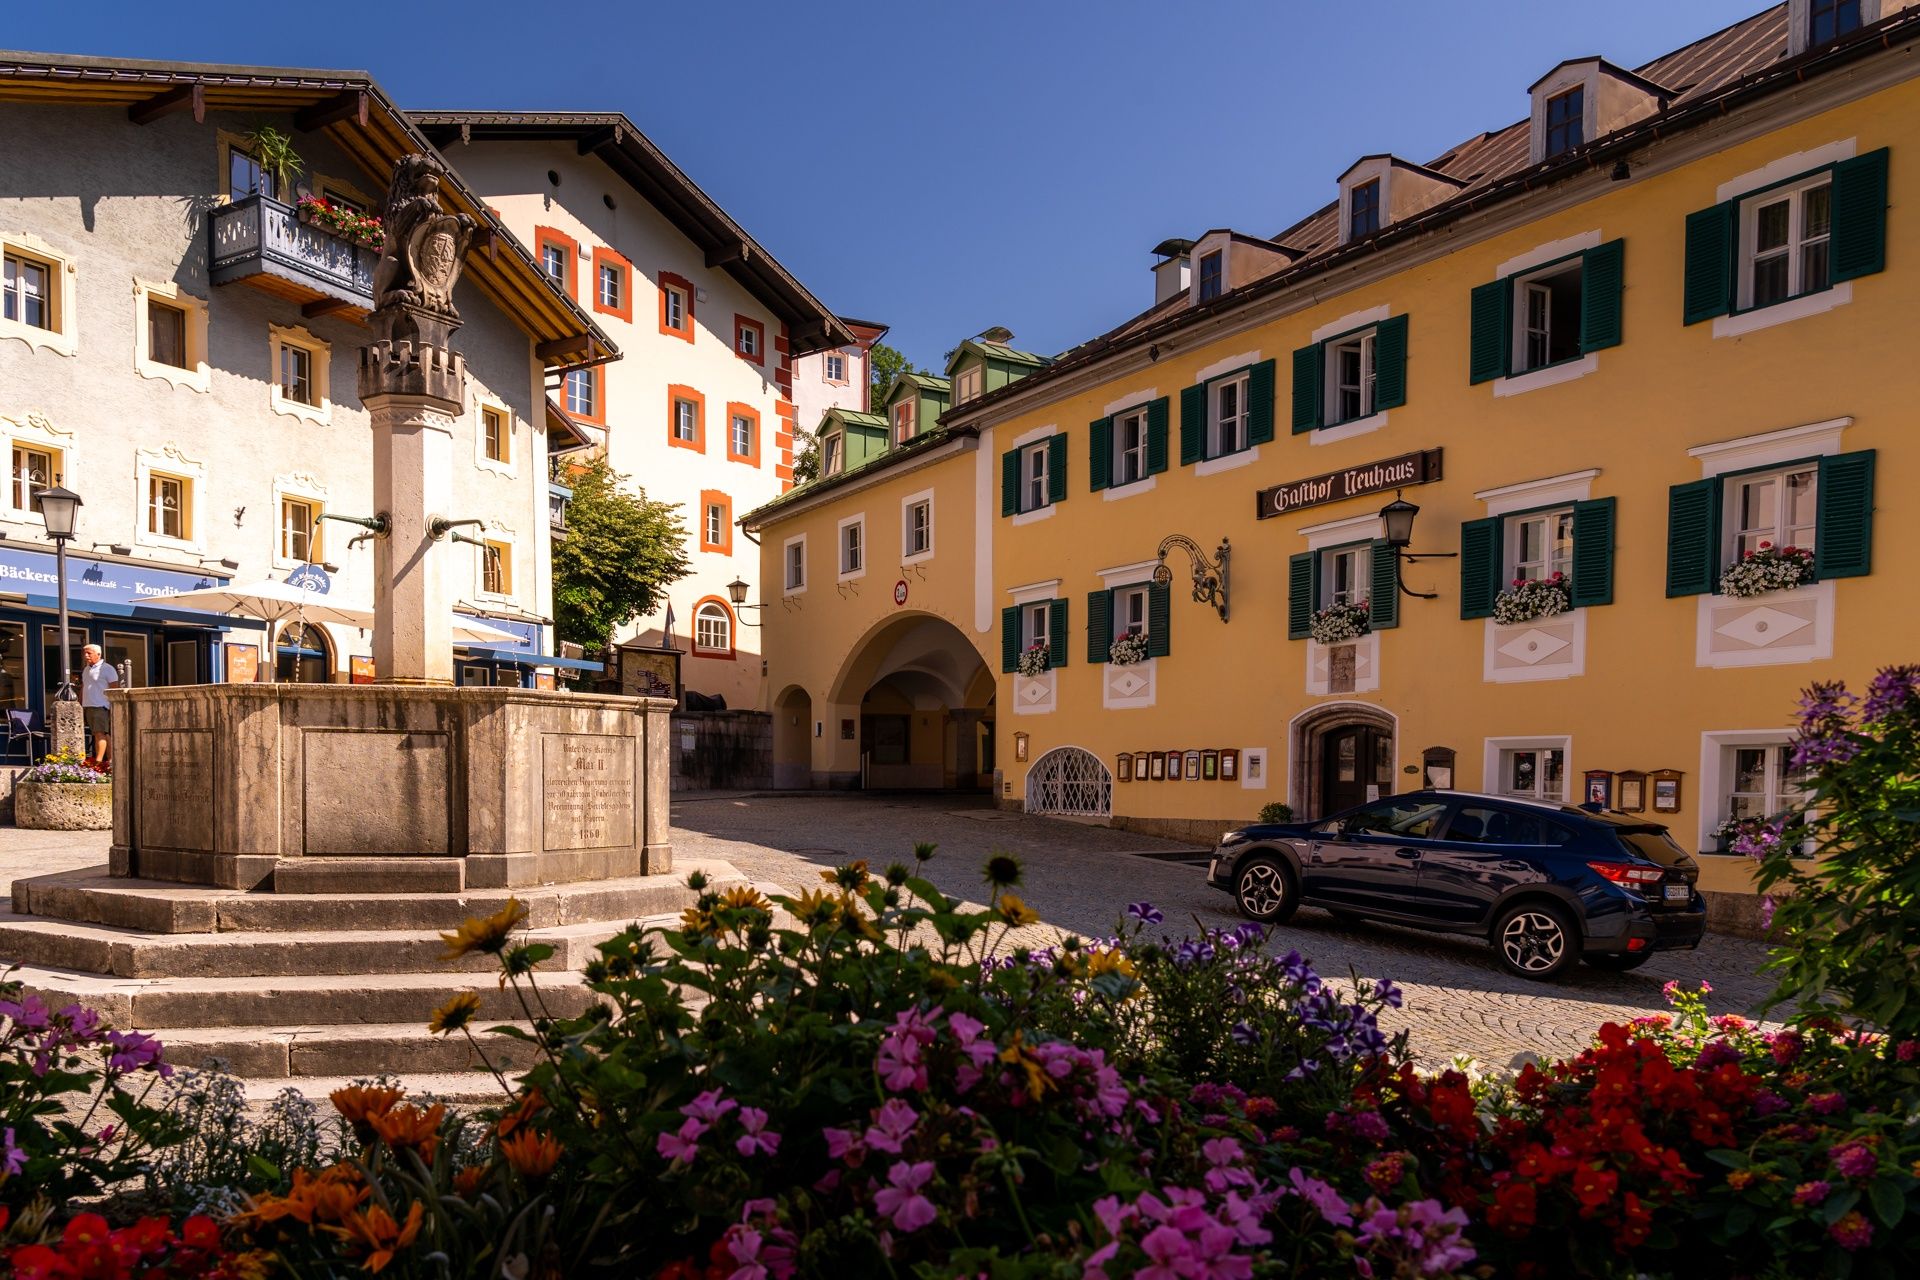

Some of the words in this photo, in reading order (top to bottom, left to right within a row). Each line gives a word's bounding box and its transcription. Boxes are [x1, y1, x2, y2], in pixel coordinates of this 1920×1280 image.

[1274, 475, 1335, 511] Gasthof
[1344, 461, 1415, 496] Neuhaus
[0, 564, 60, 584] Bäckere
[82, 578, 117, 589] Marktcafé
[135, 582, 181, 597] Kondit
